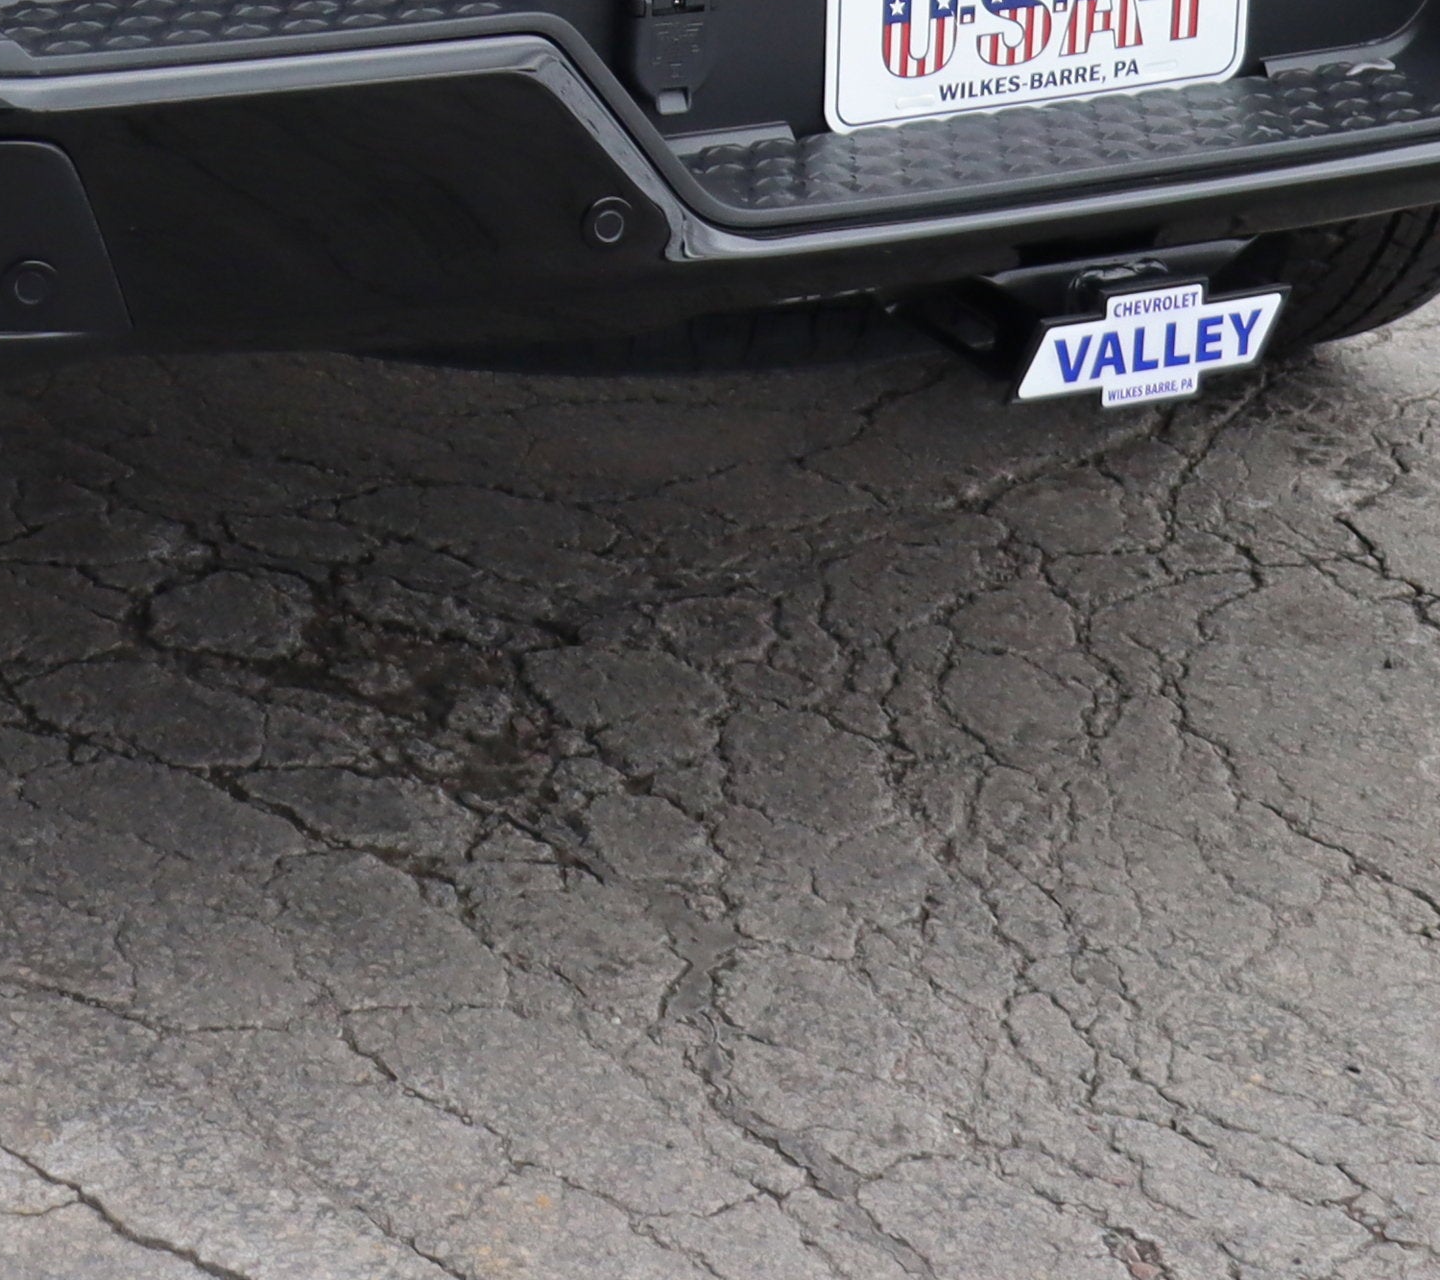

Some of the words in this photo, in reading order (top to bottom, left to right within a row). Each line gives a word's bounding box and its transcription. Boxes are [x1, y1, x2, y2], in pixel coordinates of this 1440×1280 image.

[938, 63, 1107, 102] WILKES-BARRE,
[1114, 58, 1140, 79] PA
[1113, 291, 1199, 319] CHEVROLET
[1053, 308, 1263, 384] VALLEY
[1107, 386, 1143, 402] WILKES
[1145, 379, 1179, 396] BARRE,
[1180, 378, 1194, 390] PA
